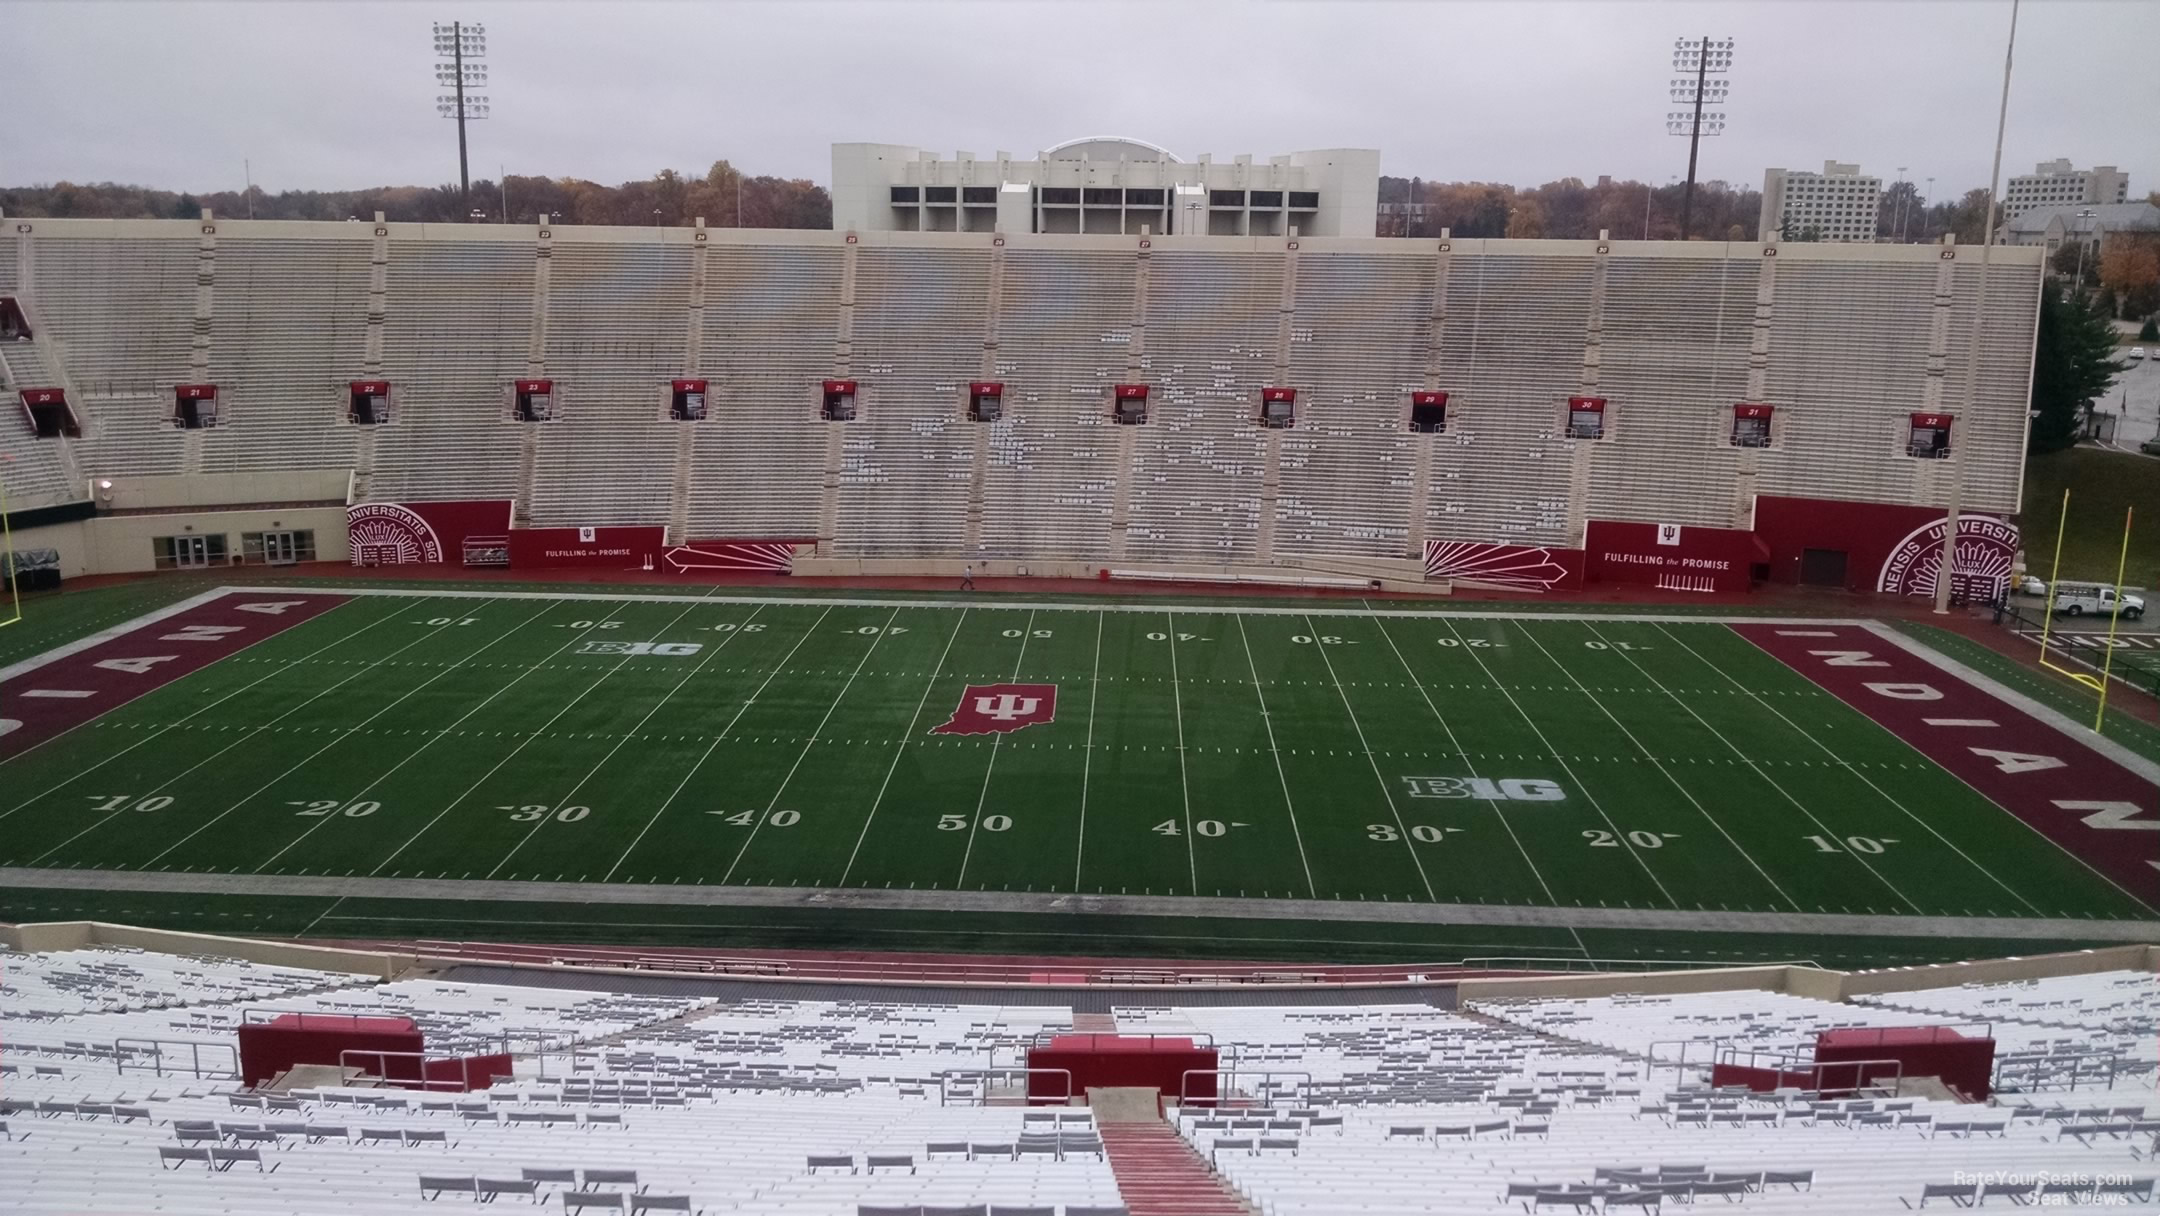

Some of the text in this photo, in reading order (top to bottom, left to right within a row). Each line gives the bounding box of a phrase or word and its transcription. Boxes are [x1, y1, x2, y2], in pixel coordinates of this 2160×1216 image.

[39, 394, 50, 402] 20
[1605, 553, 1729, 570] FULFILLING the PROMISE
[1885, 541, 1920, 593] NENSIS
[1961, 560, 1980, 569] LUX
[91, 795, 175, 811] 10
[295, 800, 381, 817] 20
[510, 804, 591, 822] 30
[724, 809, 801, 827] 40
[937, 814, 1013, 831] 50
[1152, 819, 1226, 837] 40
[1366, 824, 1444, 843] 30
[1582, 830, 1663, 848] 20
[1802, 836, 1885, 853] 10
